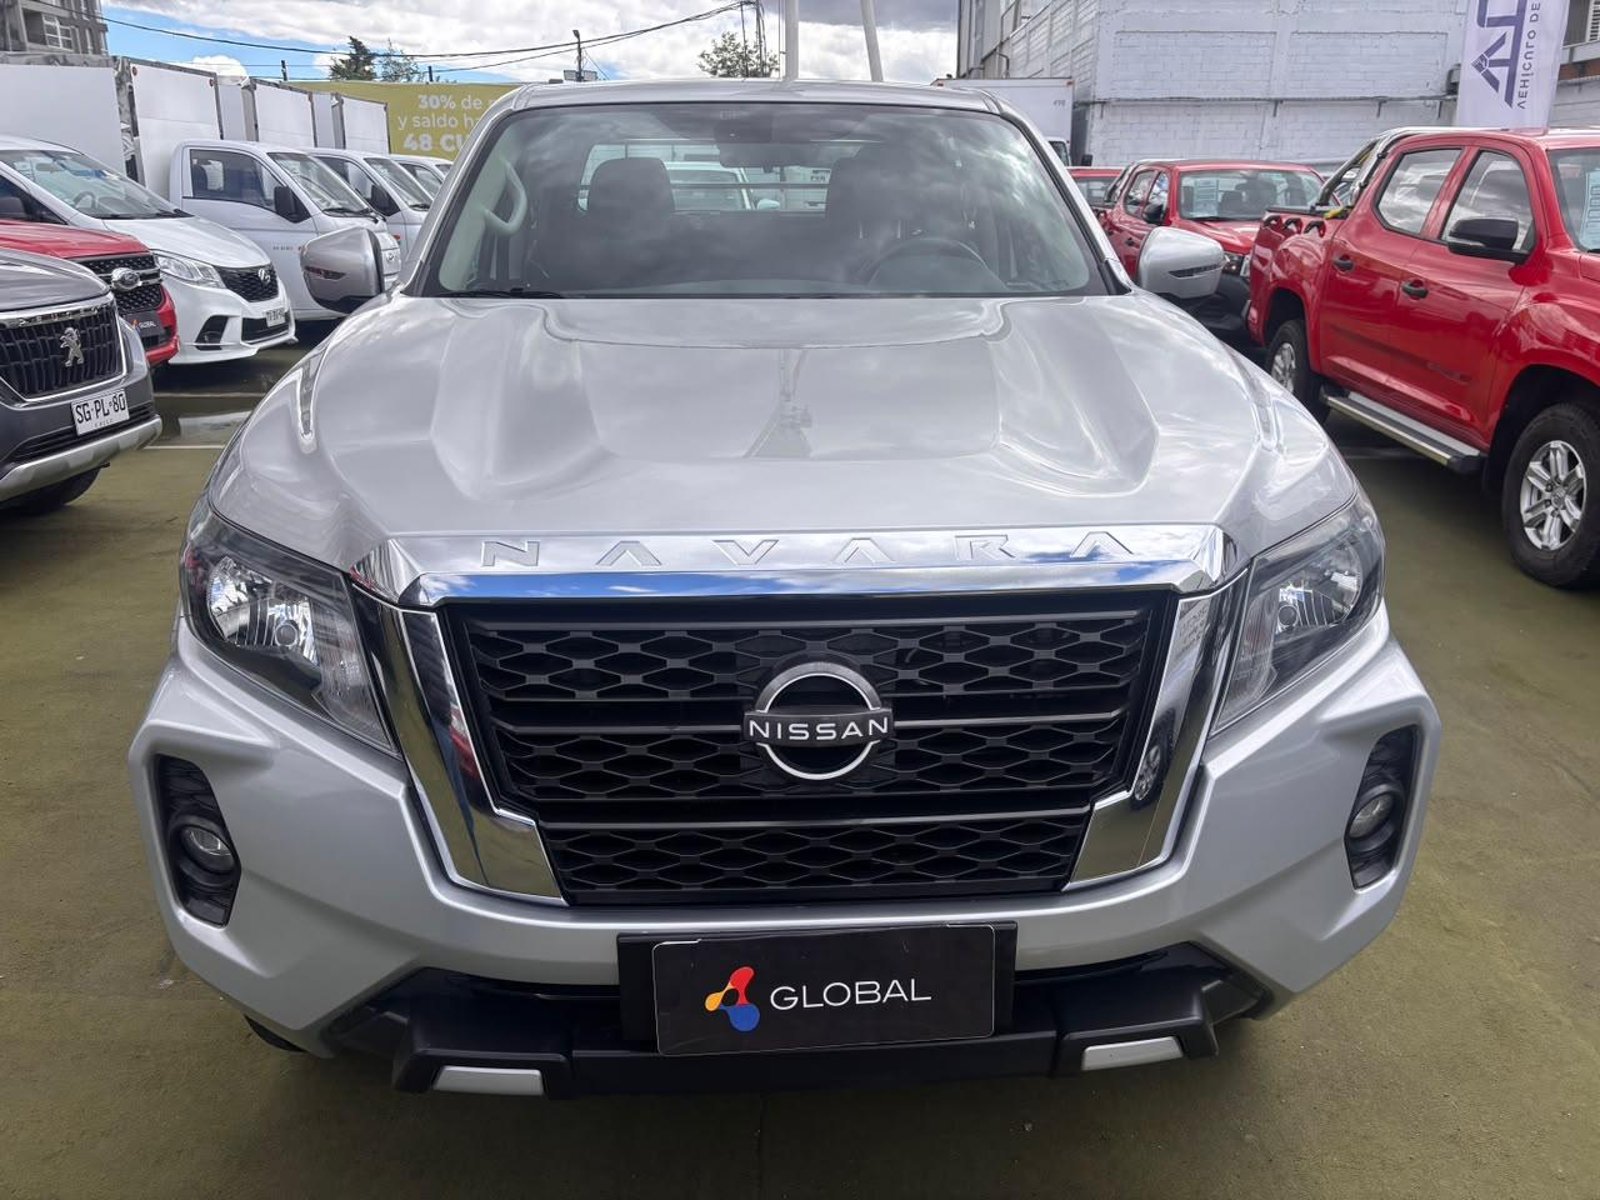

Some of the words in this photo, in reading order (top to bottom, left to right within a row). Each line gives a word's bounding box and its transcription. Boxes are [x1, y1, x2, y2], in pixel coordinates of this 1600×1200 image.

[418, 95, 456, 109] 30%
[461, 95, 482, 109] de
[398, 116, 407, 130] y
[412, 114, 458, 129] saldo
[403, 133, 433, 151] 48
[481, 530, 1134, 567] NAVARA
[749, 716, 889, 741] NISSAN
[770, 978, 932, 1011] GLOBAL
